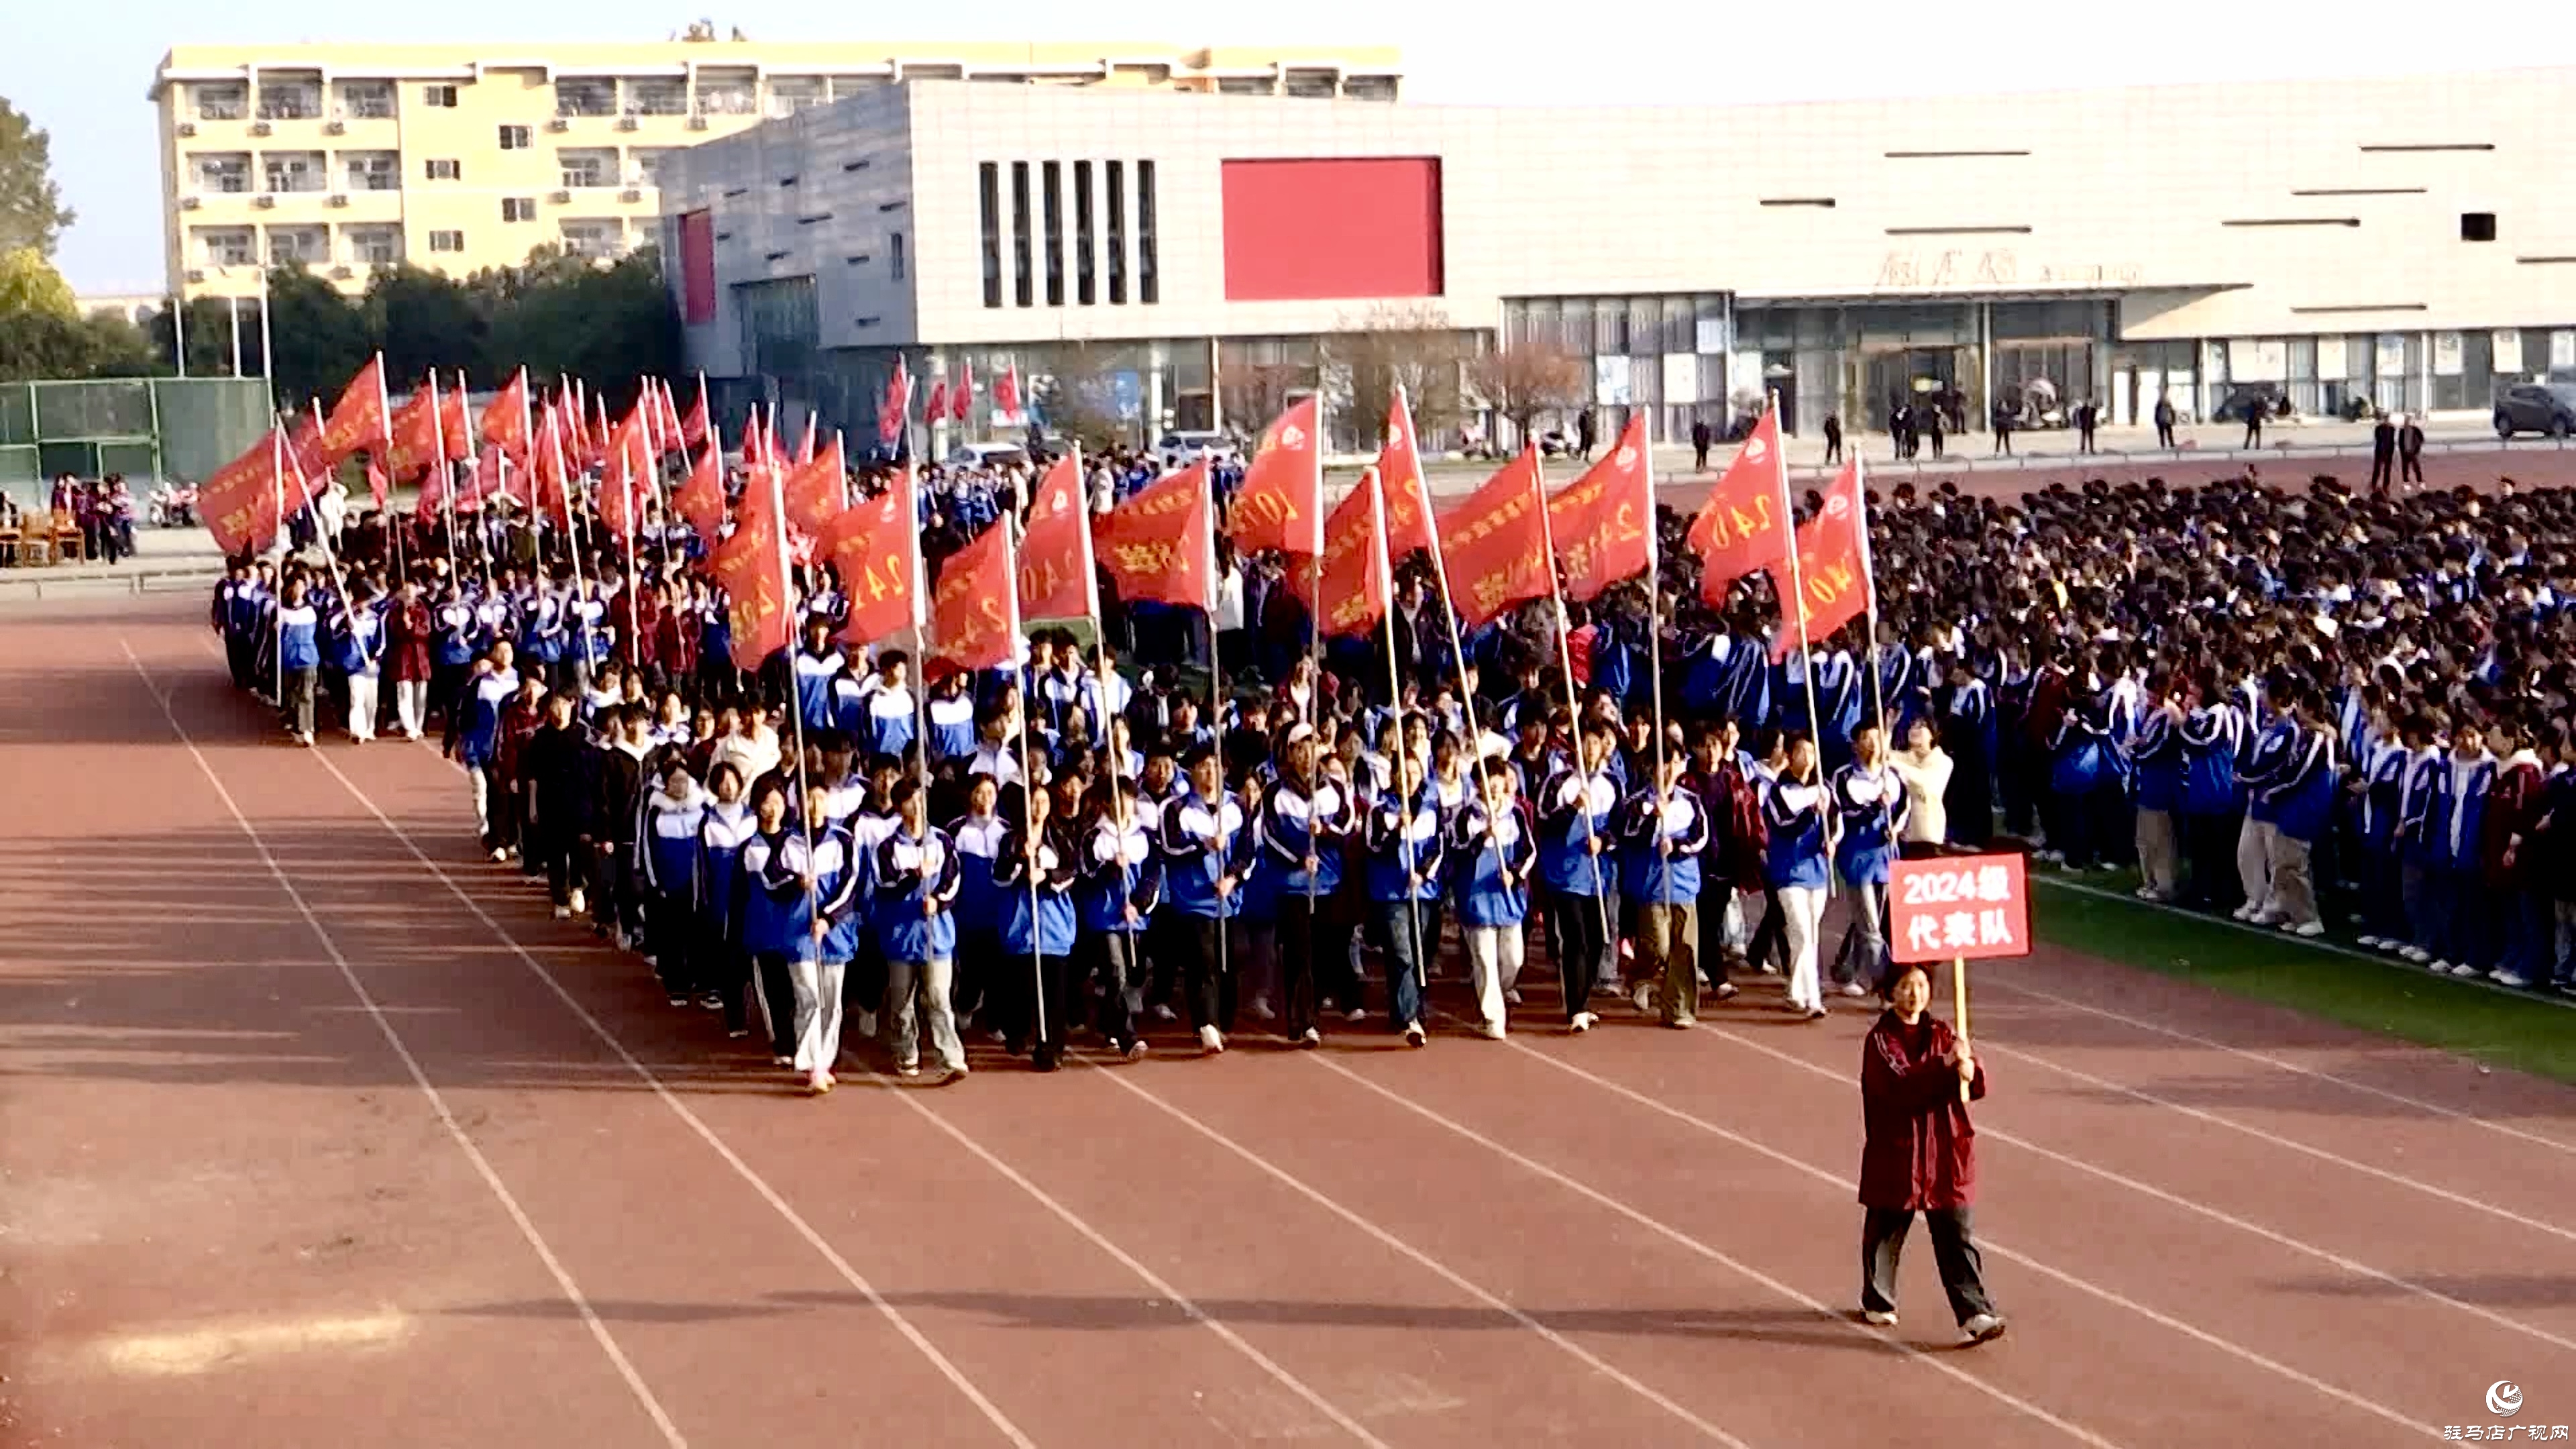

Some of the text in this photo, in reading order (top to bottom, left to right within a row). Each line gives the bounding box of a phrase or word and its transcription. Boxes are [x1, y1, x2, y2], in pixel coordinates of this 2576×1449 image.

[1903, 865, 2011, 904] 2024级
[1907, 908, 2012, 951] 代表队
